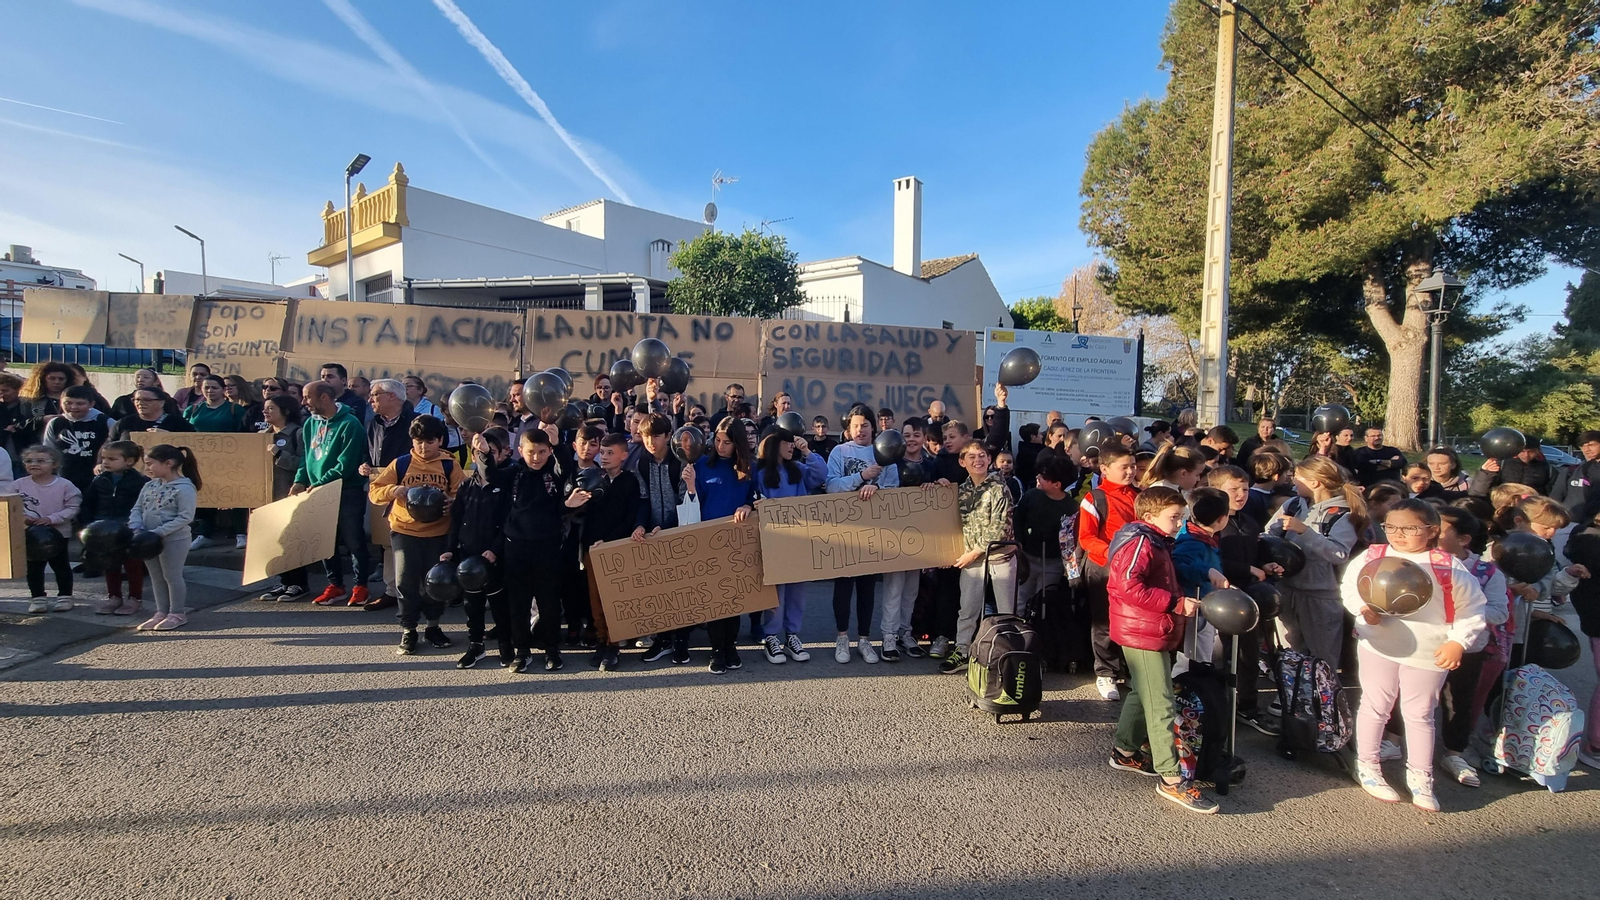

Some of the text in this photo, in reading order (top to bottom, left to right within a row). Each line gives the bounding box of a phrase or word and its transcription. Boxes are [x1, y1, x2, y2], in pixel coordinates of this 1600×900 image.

[202, 301, 265, 321] TODO
[535, 313, 734, 342] LA JUNTA NO
[198, 322, 238, 340] SON
[771, 322, 962, 353] CON LA SALUD Y
[210, 362, 242, 375] SIN
[783, 376, 826, 410] NO
[833, 382, 874, 415] SE
[878, 384, 964, 415] JUEGA
[870, 486, 955, 520] MUCHO
[599, 525, 758, 576] LO UNICO QUE
[810, 526, 925, 570] MIEDO
[611, 557, 721, 593] TENEMOS
[612, 581, 713, 622] PREGUNTAS
[631, 594, 745, 635] RESPUESTAS
[1014, 661, 1027, 700] umbro
